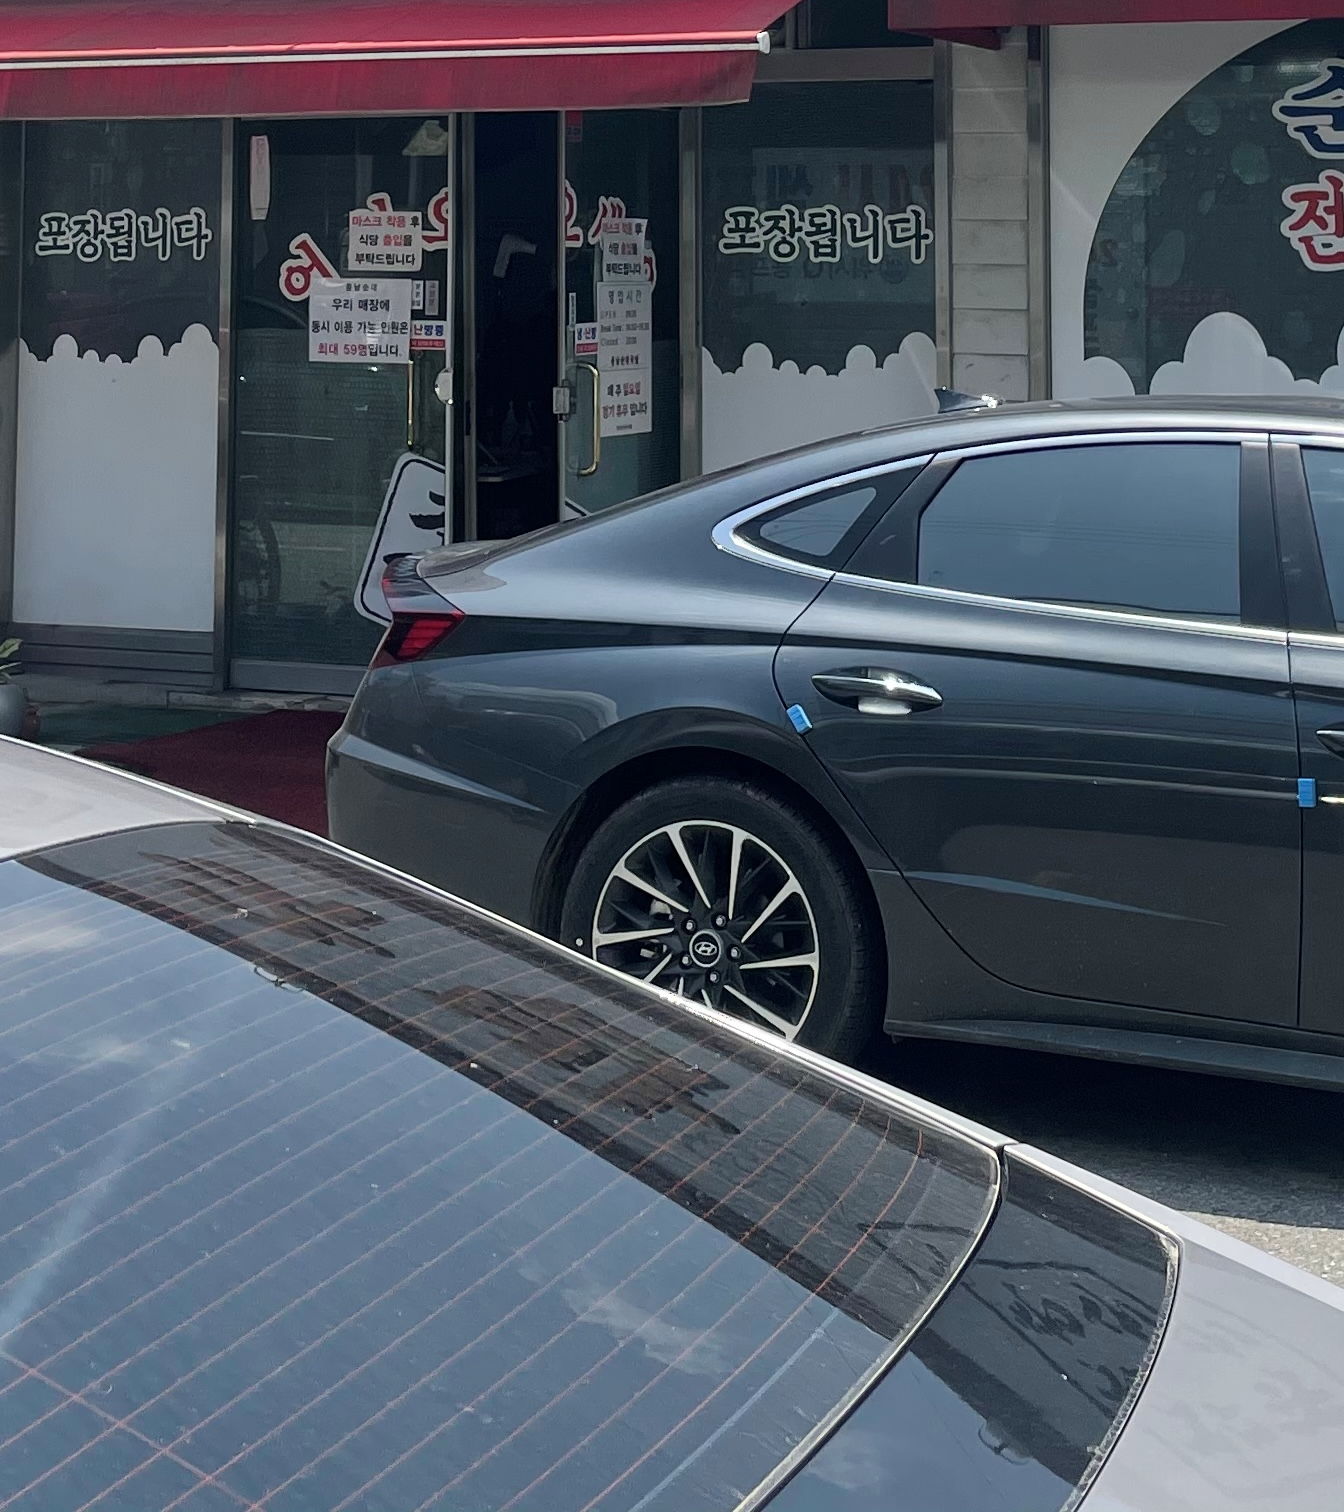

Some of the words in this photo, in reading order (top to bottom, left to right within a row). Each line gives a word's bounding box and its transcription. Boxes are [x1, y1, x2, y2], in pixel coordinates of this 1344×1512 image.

[352, 216, 382, 226] 마스크
[386, 216, 406, 227] 착용
[409, 215, 420, 228] 후
[35, 207, 213, 263] 포장됩니다
[359, 234, 379, 246] 식당
[383, 234, 412, 247] 출입을
[718, 204, 934, 264] 포장됩니다
[355, 253, 416, 265] 부탁드립니다
[332, 298, 353, 311] 우리
[358, 298, 390, 312] 매장에
[311, 320, 330, 334] 동시
[334, 320, 353, 334] 이용
[380, 321, 408, 335] 인원은
[318, 342, 339, 356] 최대
